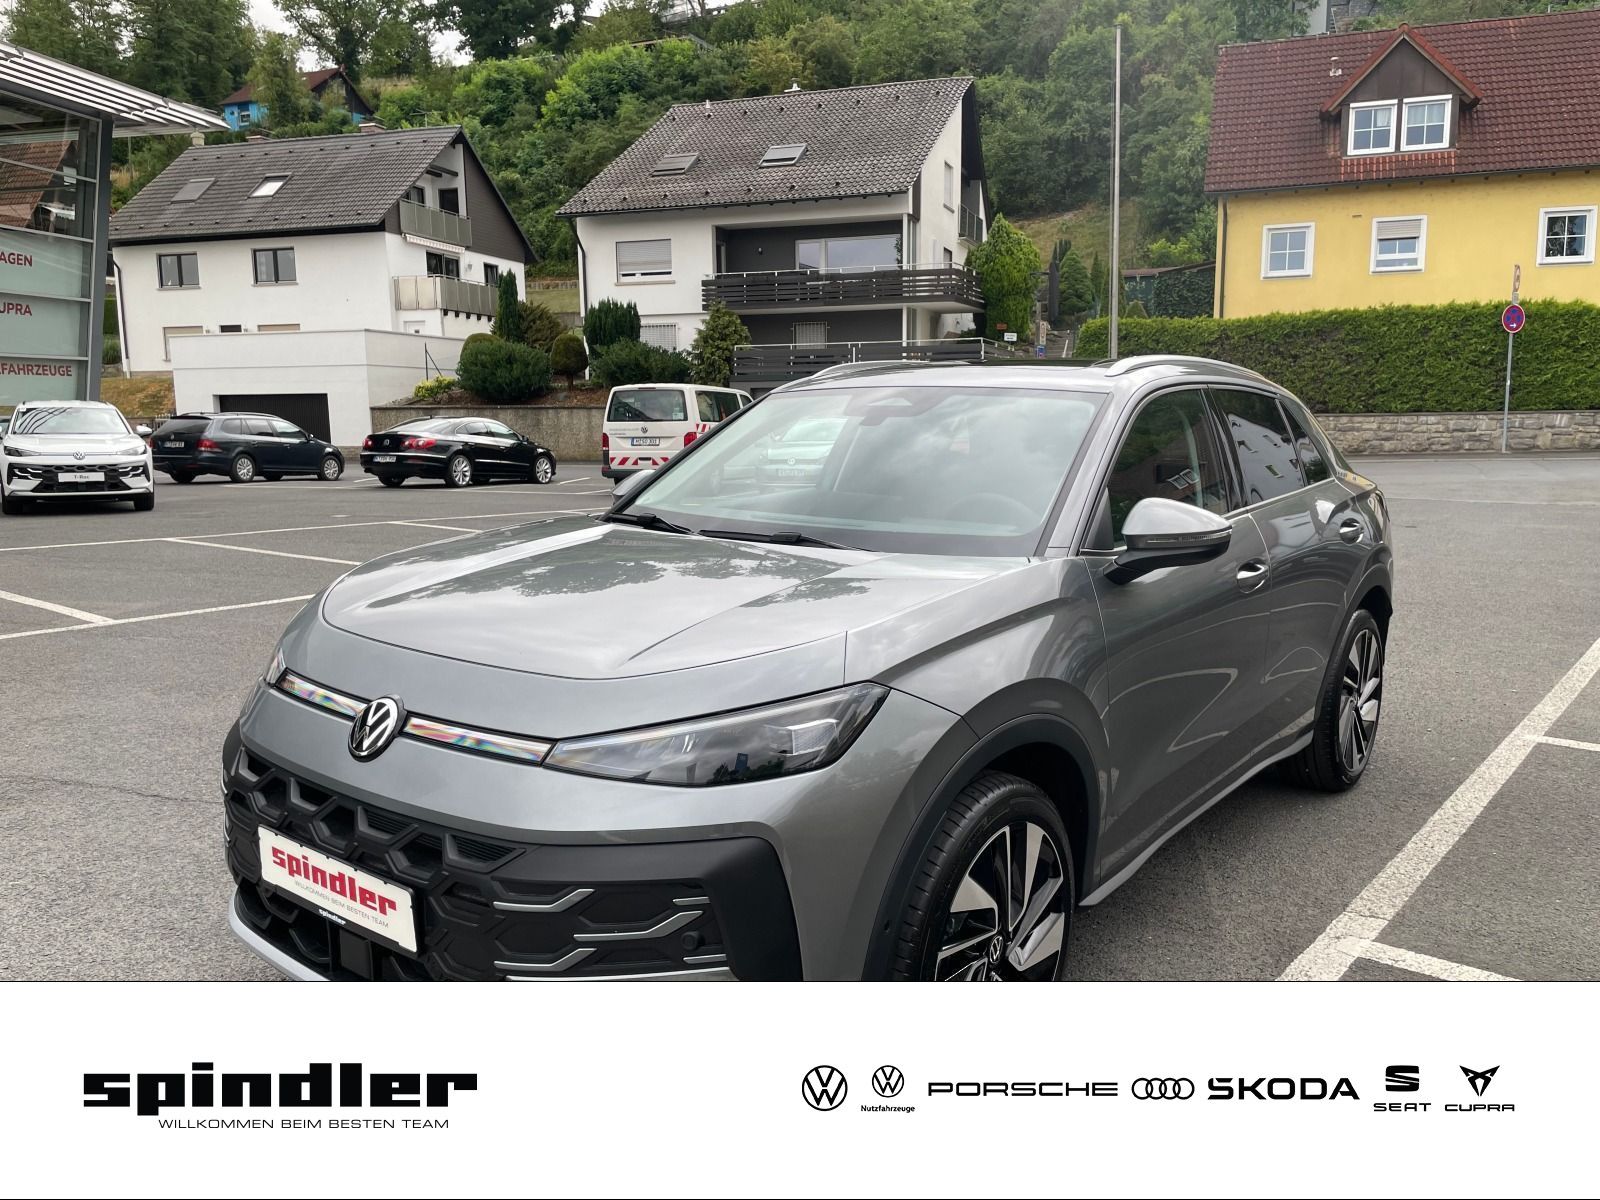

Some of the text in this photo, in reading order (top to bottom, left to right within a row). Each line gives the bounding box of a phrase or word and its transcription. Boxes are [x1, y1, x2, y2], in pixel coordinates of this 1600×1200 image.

[0, 252, 33, 267] AGEN
[0, 363, 73, 377] FAHRZEUGE
[271, 846, 397, 916] spindler
[295, 881, 389, 929] WILLKOMMEN BEIM BESTEN TEAM
[318, 908, 347, 926] spindler
